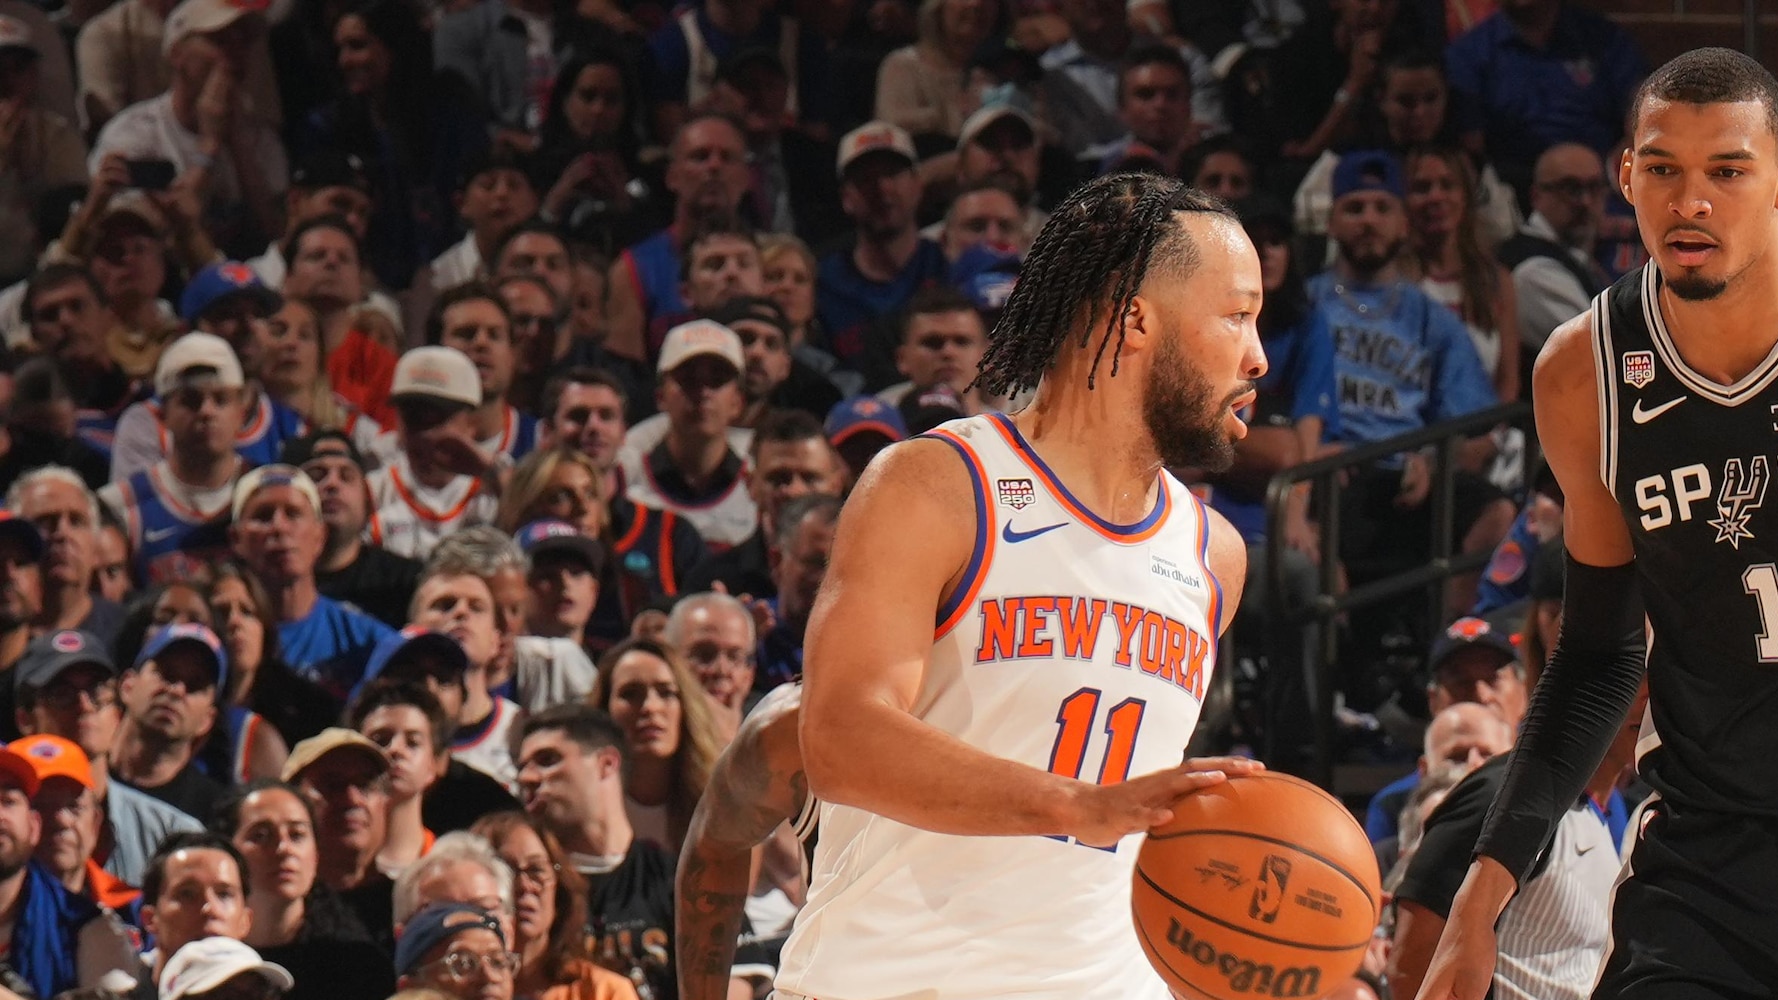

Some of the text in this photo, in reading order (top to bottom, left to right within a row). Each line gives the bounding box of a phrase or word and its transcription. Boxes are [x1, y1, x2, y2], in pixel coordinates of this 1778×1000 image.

[1626, 355, 1650, 365] USA
[1626, 369, 1652, 380] 250
[1000, 481, 1030, 491] USA
[1000, 494, 1036, 505] 250
[1151, 563, 1201, 588] abu dhabi
[973, 596, 1210, 702] NEW YORK
[1166, 916, 1322, 999] Wilson
